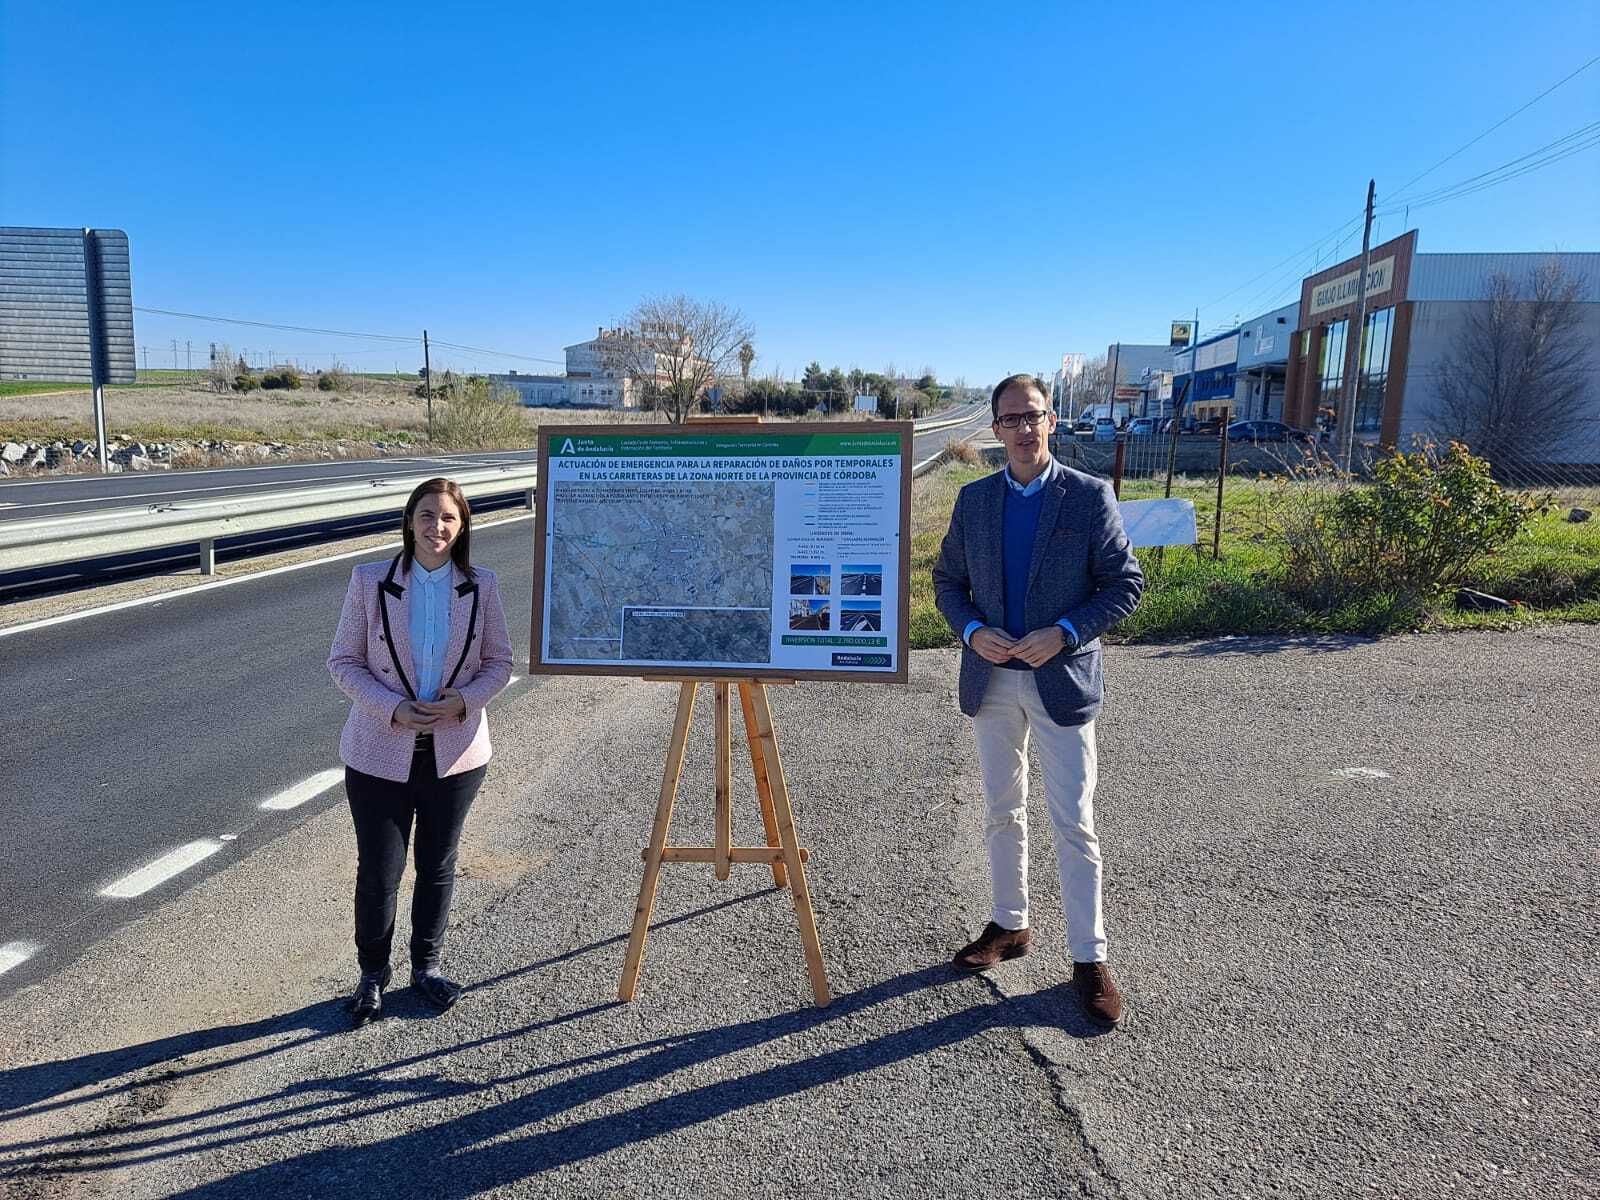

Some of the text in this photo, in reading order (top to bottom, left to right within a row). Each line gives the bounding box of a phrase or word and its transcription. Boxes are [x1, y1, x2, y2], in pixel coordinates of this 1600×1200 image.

[558, 458, 894, 469] ACTUACIÓN DE EMERGENCIA PARA LA REPARACIÓN DE DAÑOS POR TEMPORALES
[580, 470, 877, 480] EN LAS CARRETERAS DE LA ZONA NORTE DE LA PROVINCIA DE CÓRDOBA
